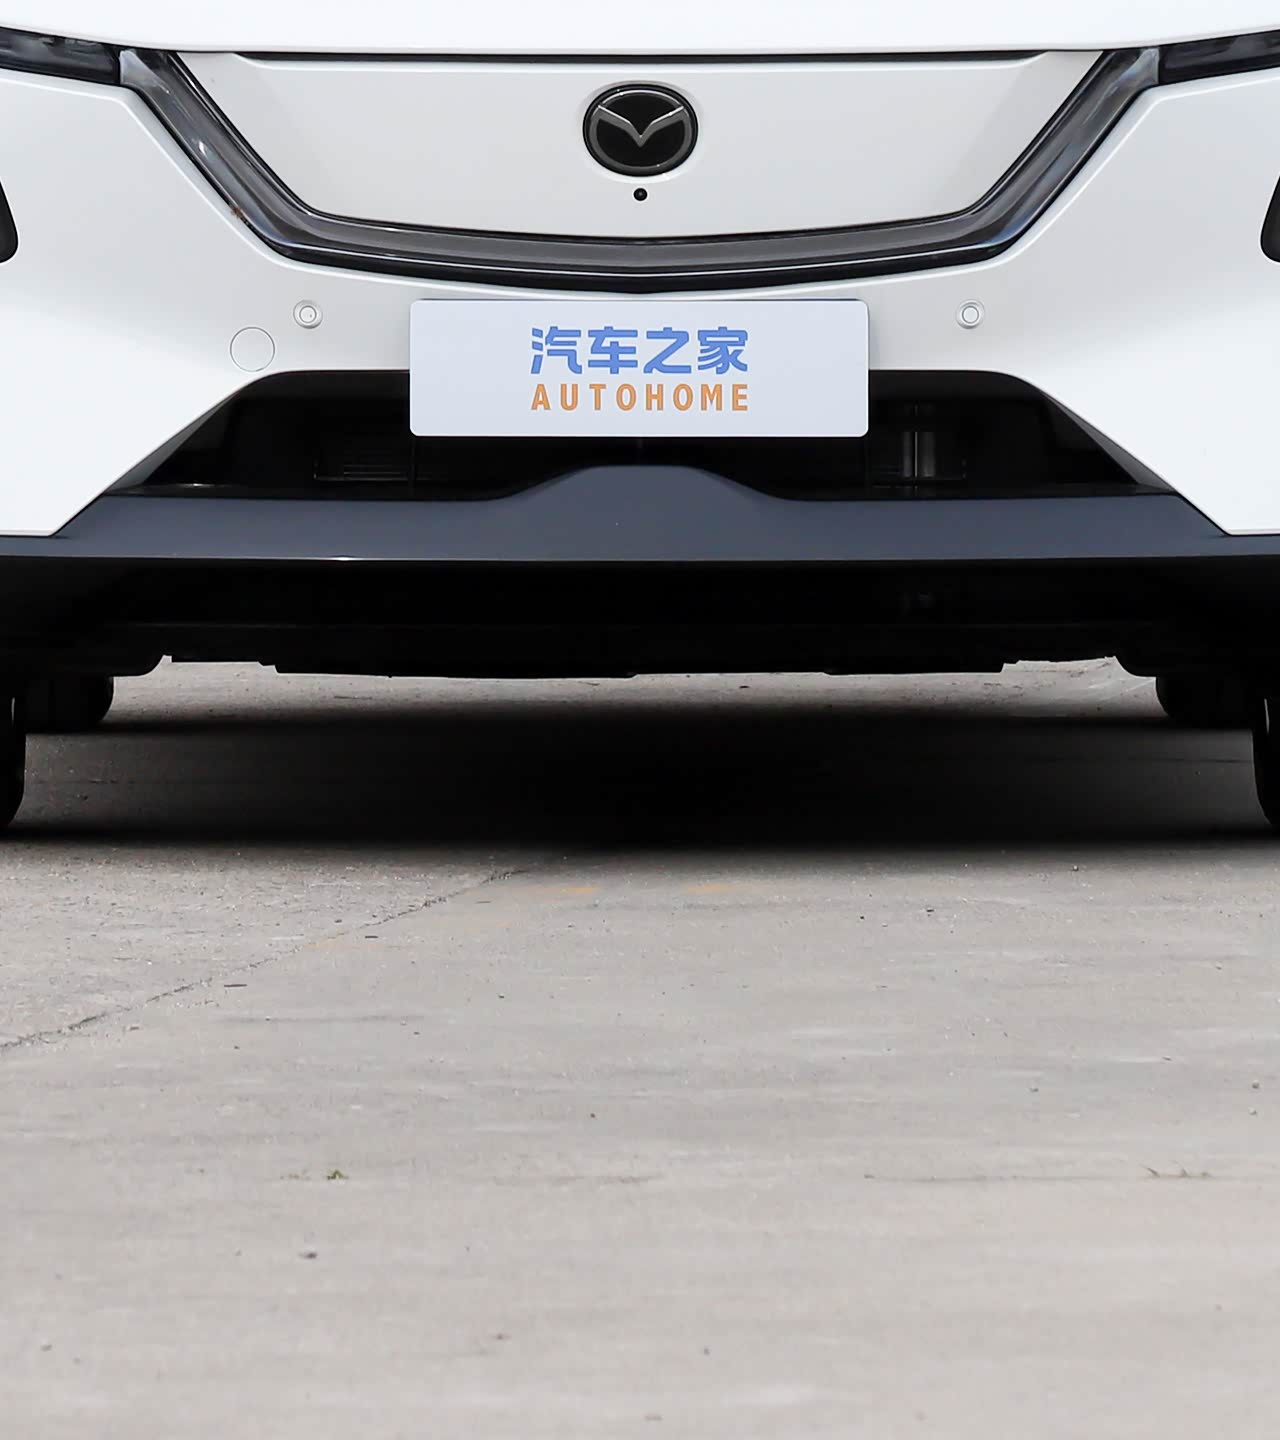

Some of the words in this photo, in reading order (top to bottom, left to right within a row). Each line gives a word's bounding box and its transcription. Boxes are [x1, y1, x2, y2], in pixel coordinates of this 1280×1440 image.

[530, 325, 749, 375] 汽车之家
[531, 383, 749, 411] AUTOHOME
